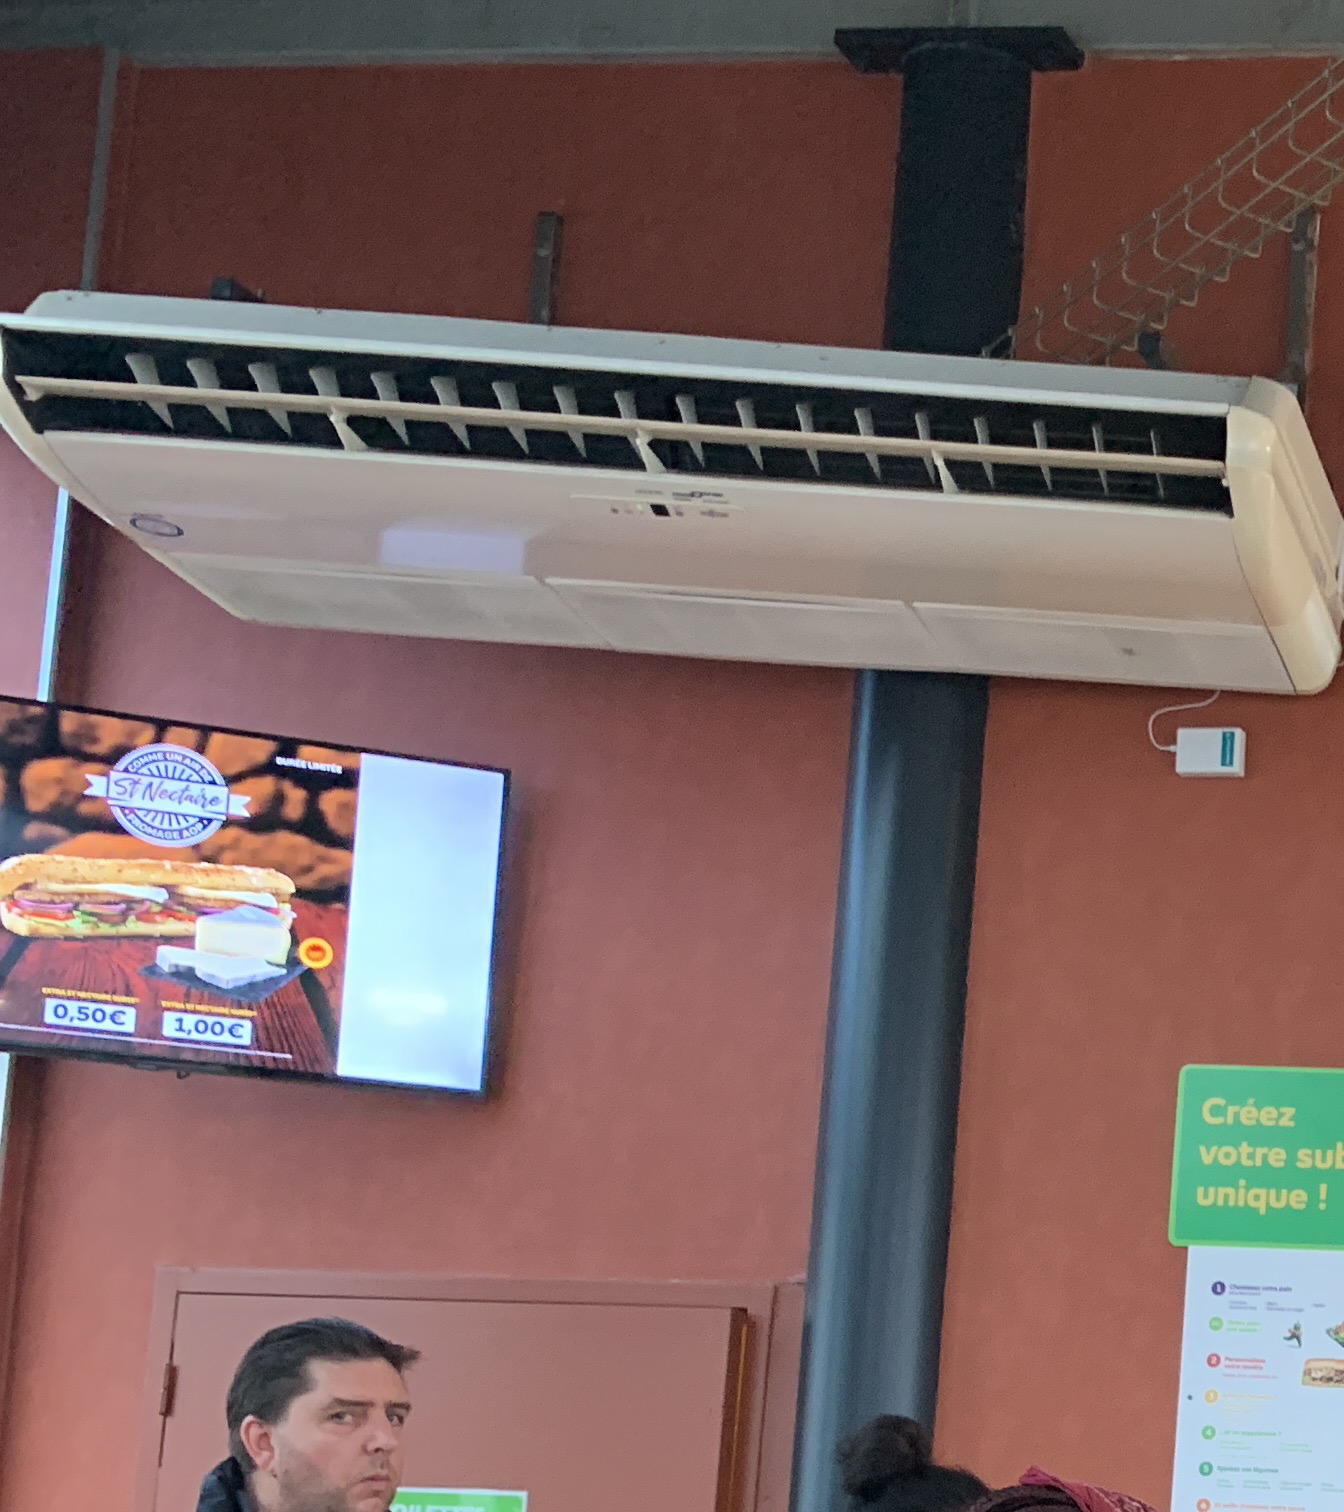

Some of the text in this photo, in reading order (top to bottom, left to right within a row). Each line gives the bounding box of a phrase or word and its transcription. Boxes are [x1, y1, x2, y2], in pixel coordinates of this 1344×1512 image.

[127, 752, 164, 773] COMME
[166, 752, 183, 763] UN
[113, 777, 224, 809] St Nectaire
[127, 812, 180, 841] FROMAGE
[53, 1003, 126, 1027] 0,50€
[174, 1017, 244, 1039] 1,00€
[1202, 1096, 1296, 1127] Créez
[1199, 1141, 1287, 1168] votre
[1196, 1179, 1328, 1216] unique !
